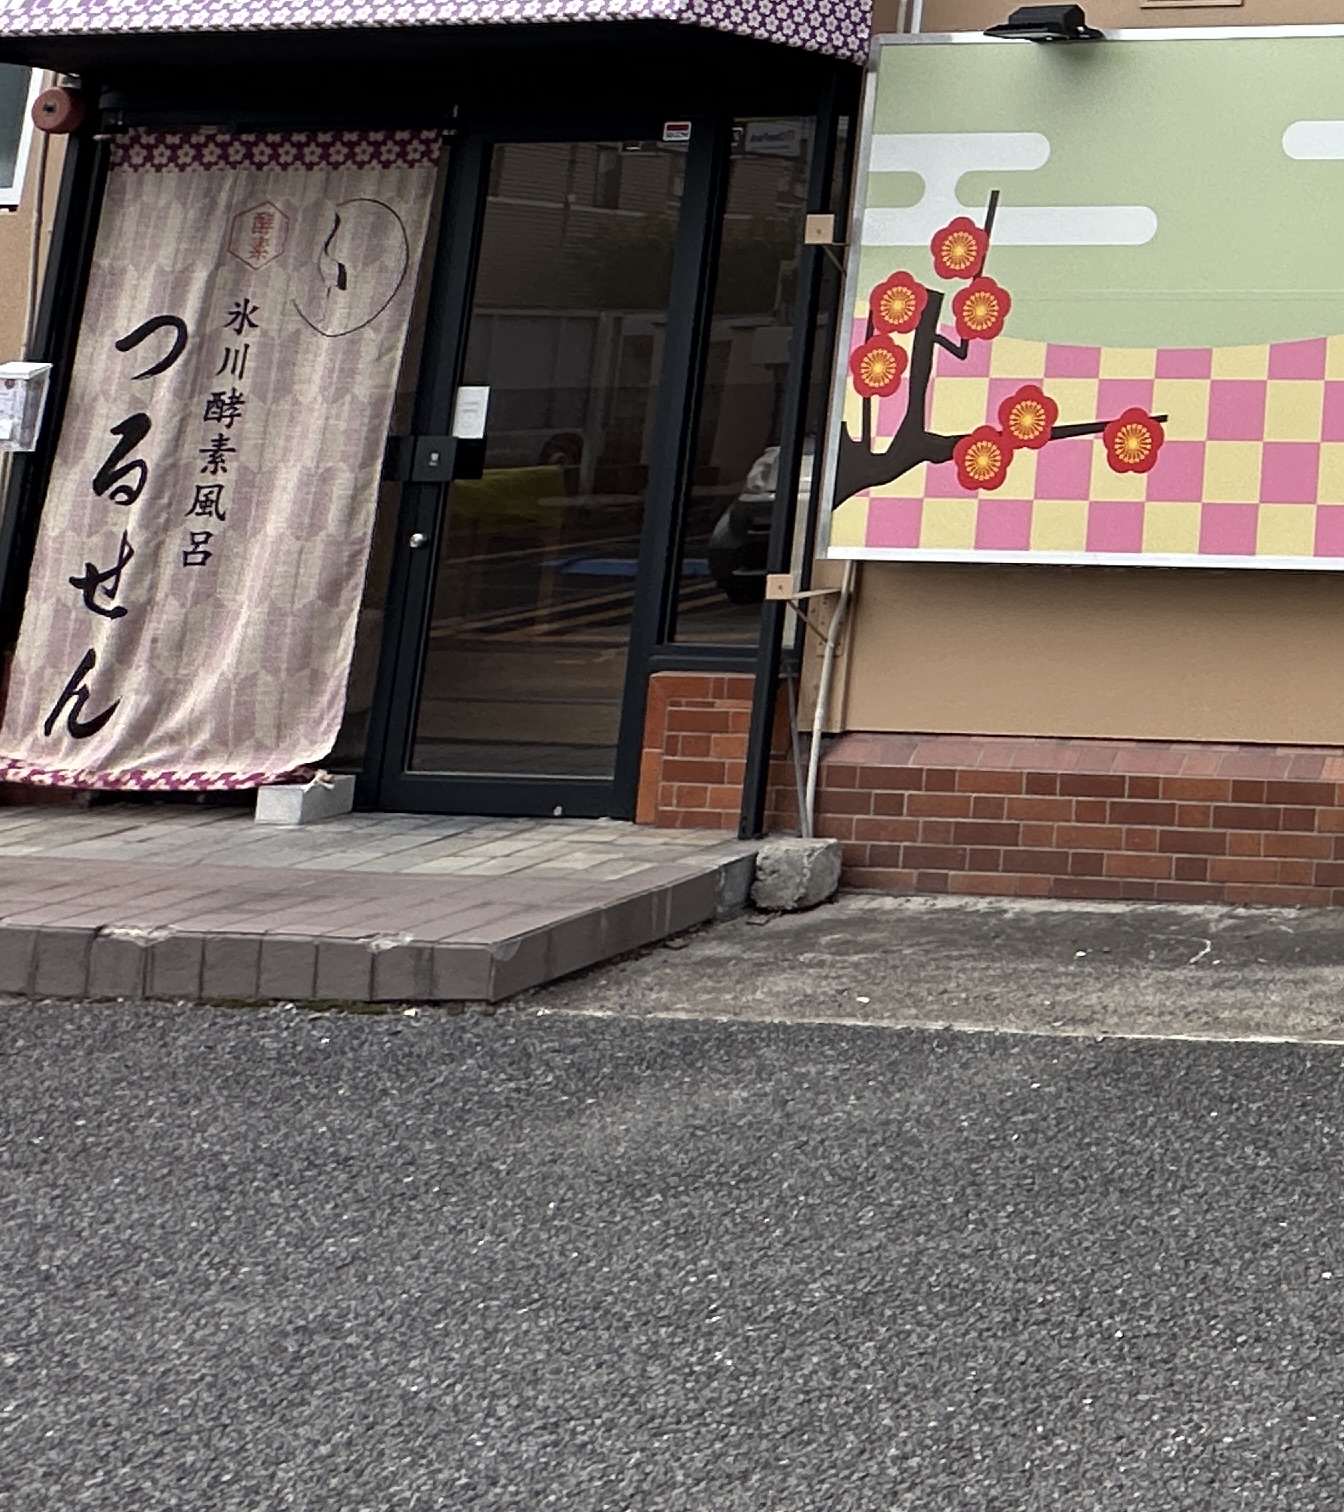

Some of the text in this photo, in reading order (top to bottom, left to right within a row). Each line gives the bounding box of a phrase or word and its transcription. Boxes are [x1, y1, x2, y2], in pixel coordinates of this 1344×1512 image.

[246, 210, 276, 262] 酵素
[43, 314, 188, 740] つるせん
[181, 297, 260, 568] 氷川酵素風呂
